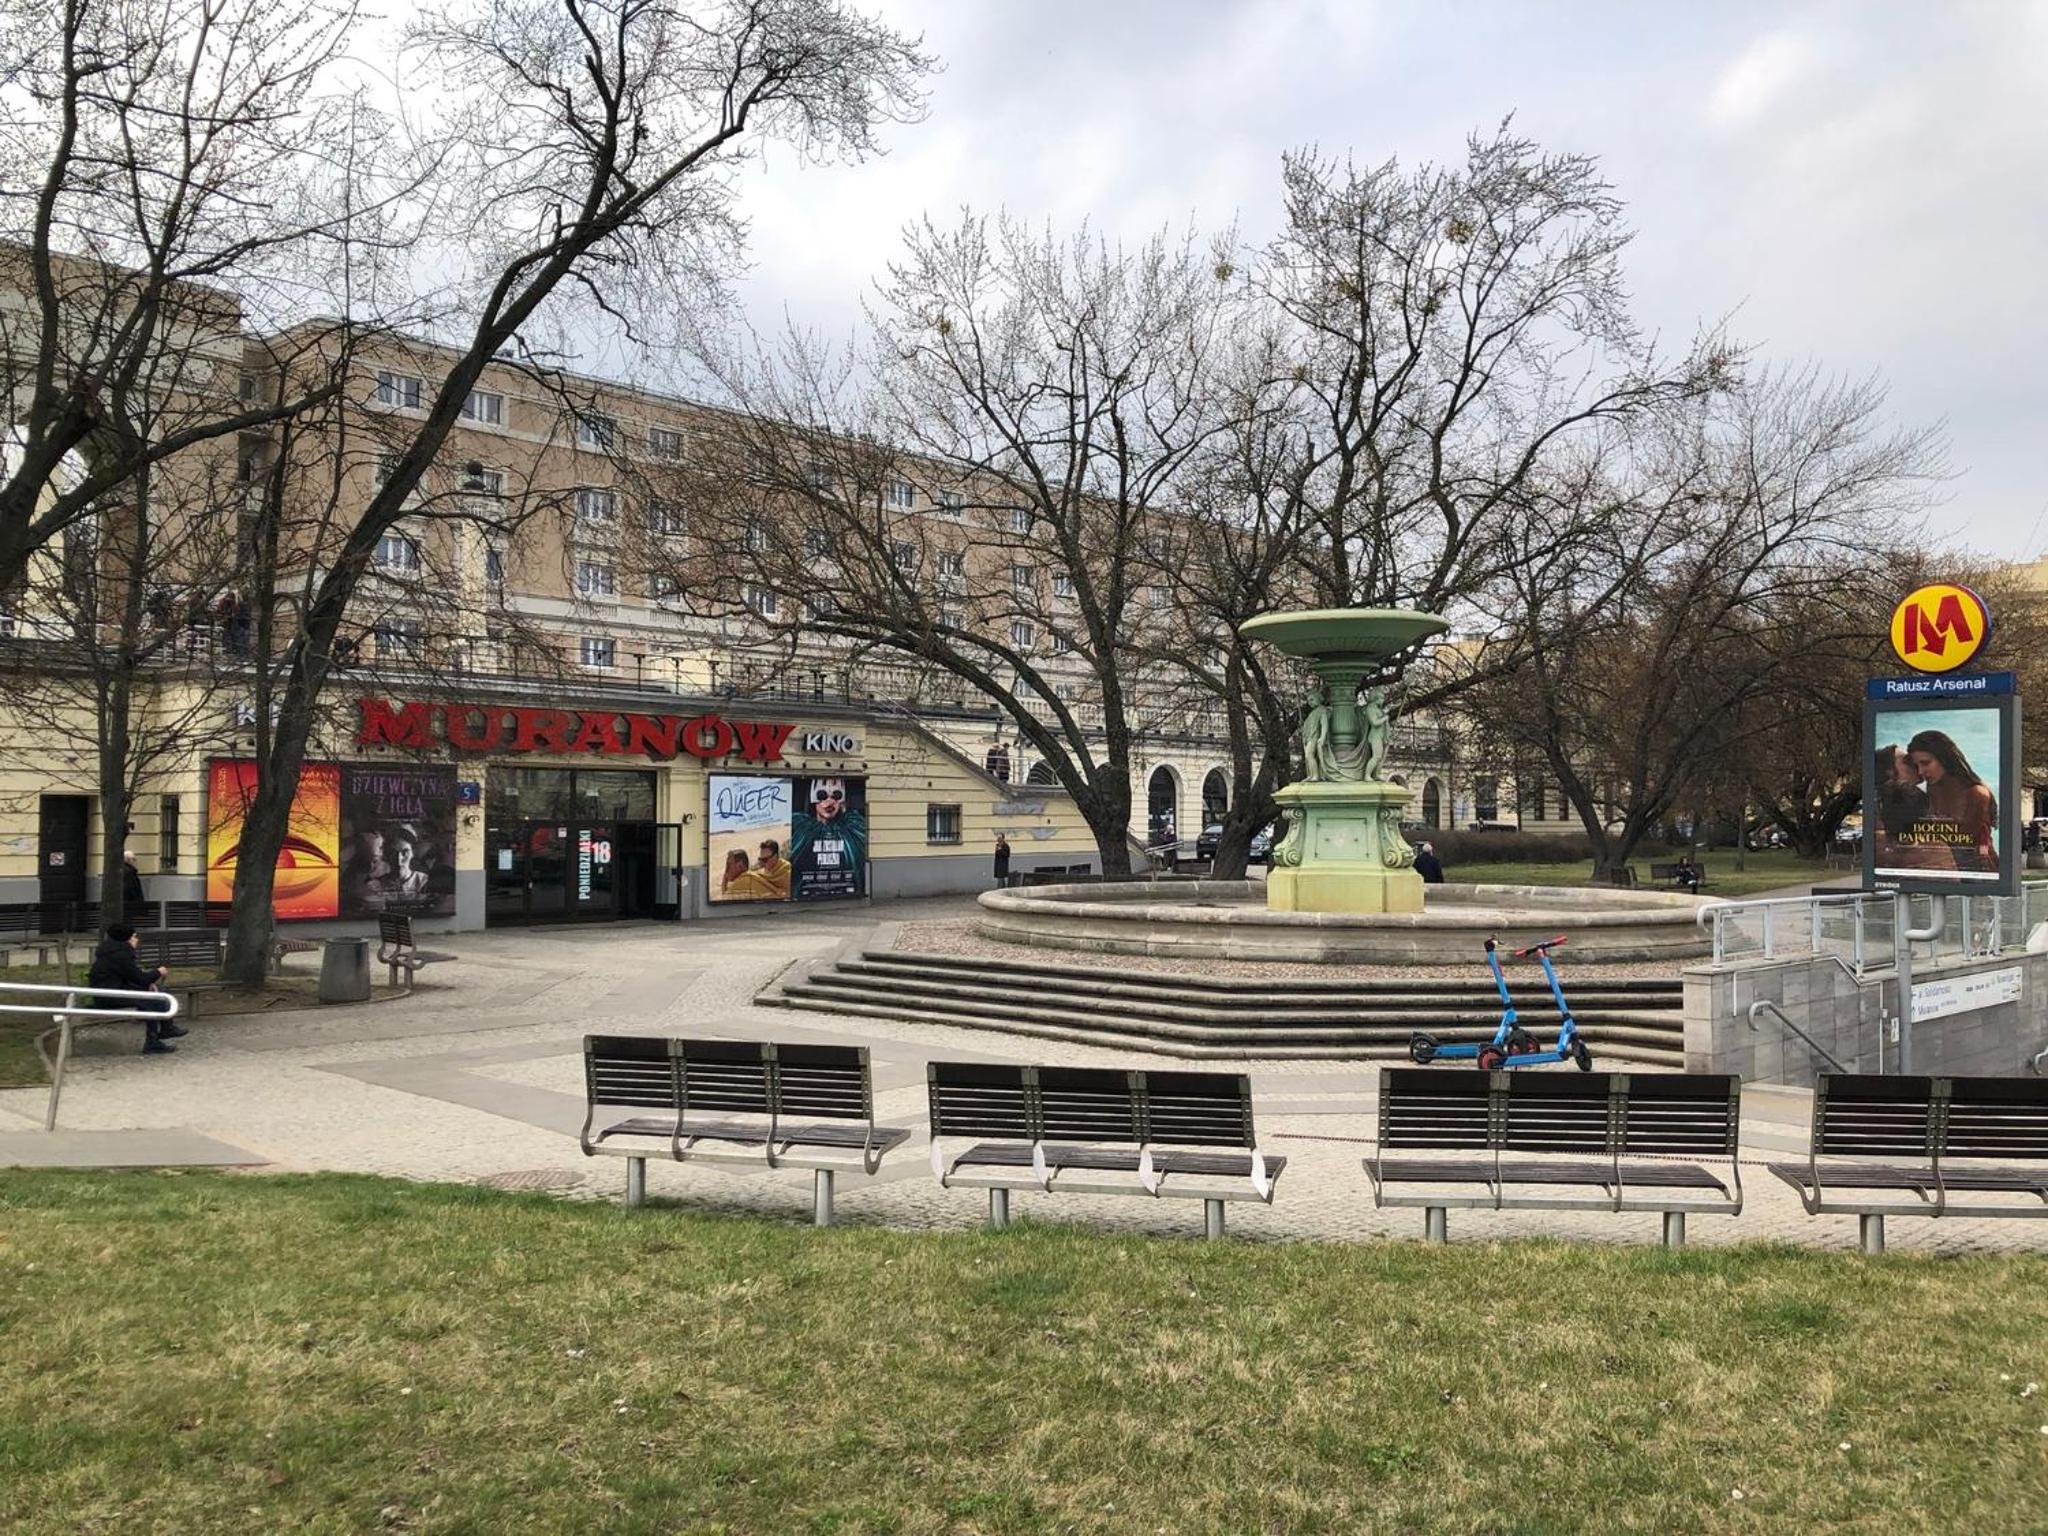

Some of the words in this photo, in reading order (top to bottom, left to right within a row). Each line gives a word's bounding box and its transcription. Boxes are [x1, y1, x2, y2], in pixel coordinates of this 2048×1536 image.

[1886, 681, 1930, 692] Ratusz
[1933, 677, 1986, 691] Arsenał
[356, 697, 796, 761] MURANÓW
[806, 733, 857, 753] KINO
[463, 787, 471, 799] 5
[714, 785, 787, 819] QUEER
[1913, 823, 1959, 833] BOGINI
[1898, 832, 1974, 843] PARTENOPE
[592, 841, 612, 864] 18
